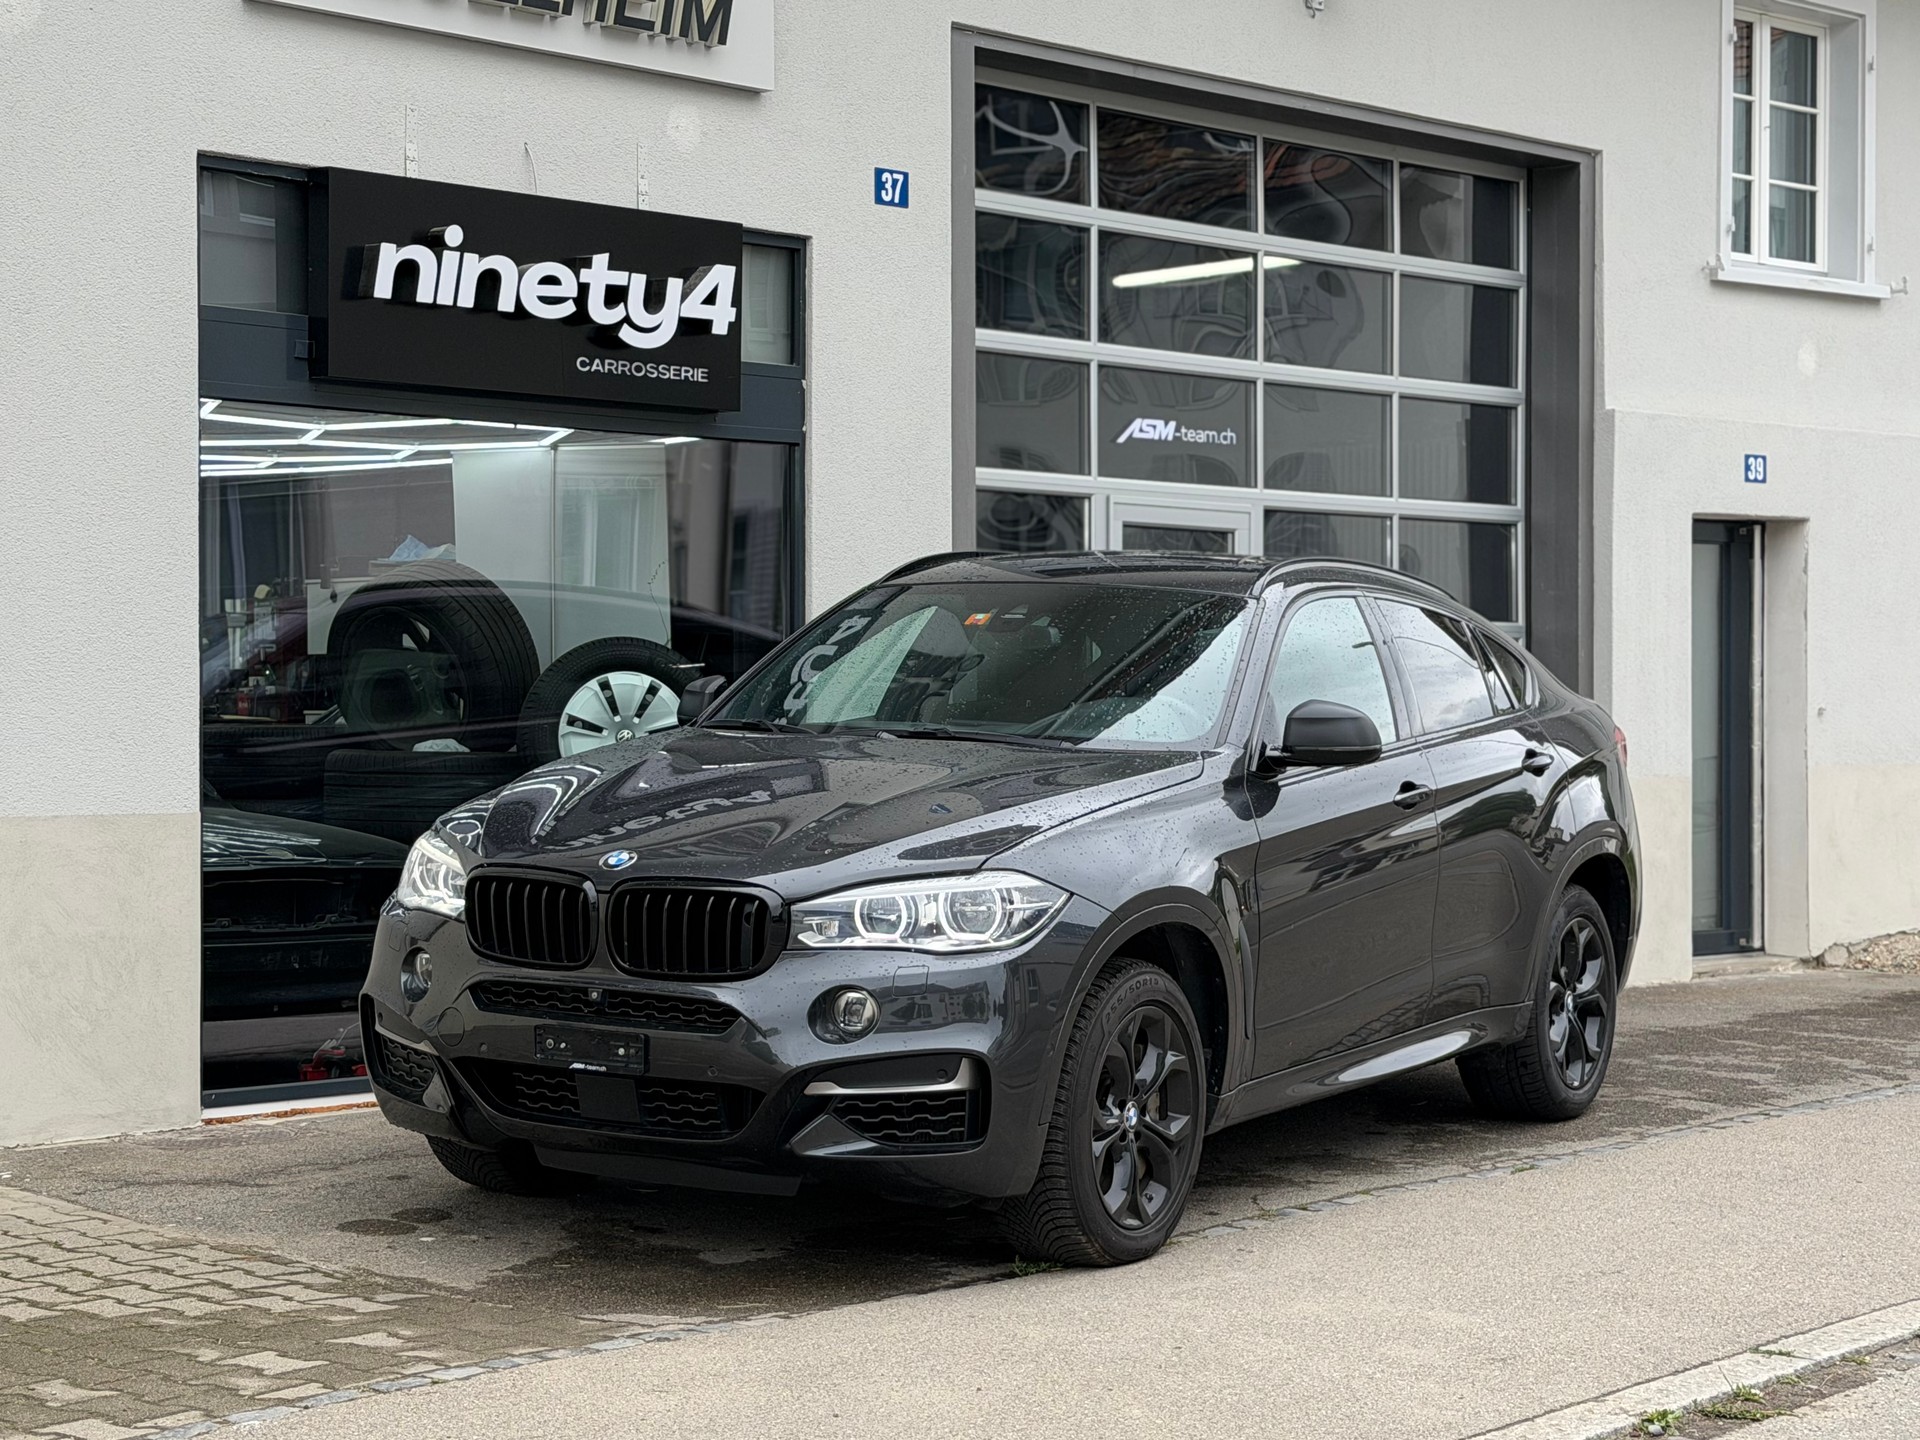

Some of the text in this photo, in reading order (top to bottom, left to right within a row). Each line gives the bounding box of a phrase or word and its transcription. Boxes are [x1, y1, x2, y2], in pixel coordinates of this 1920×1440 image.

[881, 172, 904, 203] 37
[373, 224, 737, 349] ninety4
[576, 357, 709, 382] CARROSSERIE
[1116, 418, 1236, 445] ASM-team.ch
[1748, 457, 1764, 480] 39
